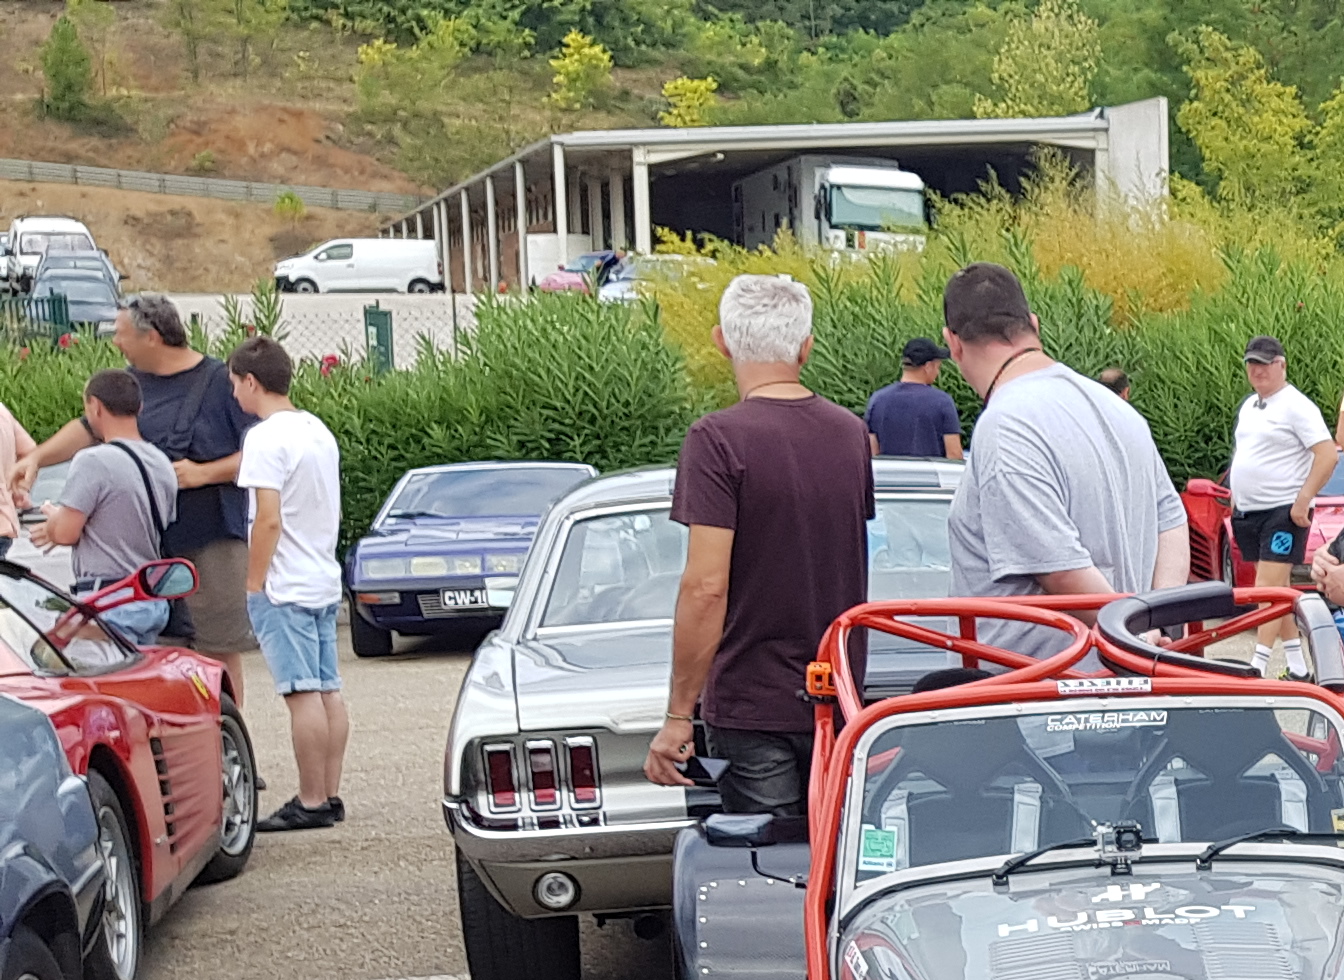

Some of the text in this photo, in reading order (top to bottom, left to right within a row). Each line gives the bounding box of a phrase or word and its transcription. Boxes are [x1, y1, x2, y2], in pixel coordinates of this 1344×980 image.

[444, 590, 488, 606] CW-1
[1048, 711, 1167, 725] CATERHAM
[1047, 722, 1120, 731] COMPETITION
[998, 906, 1255, 937] HUBLOT
